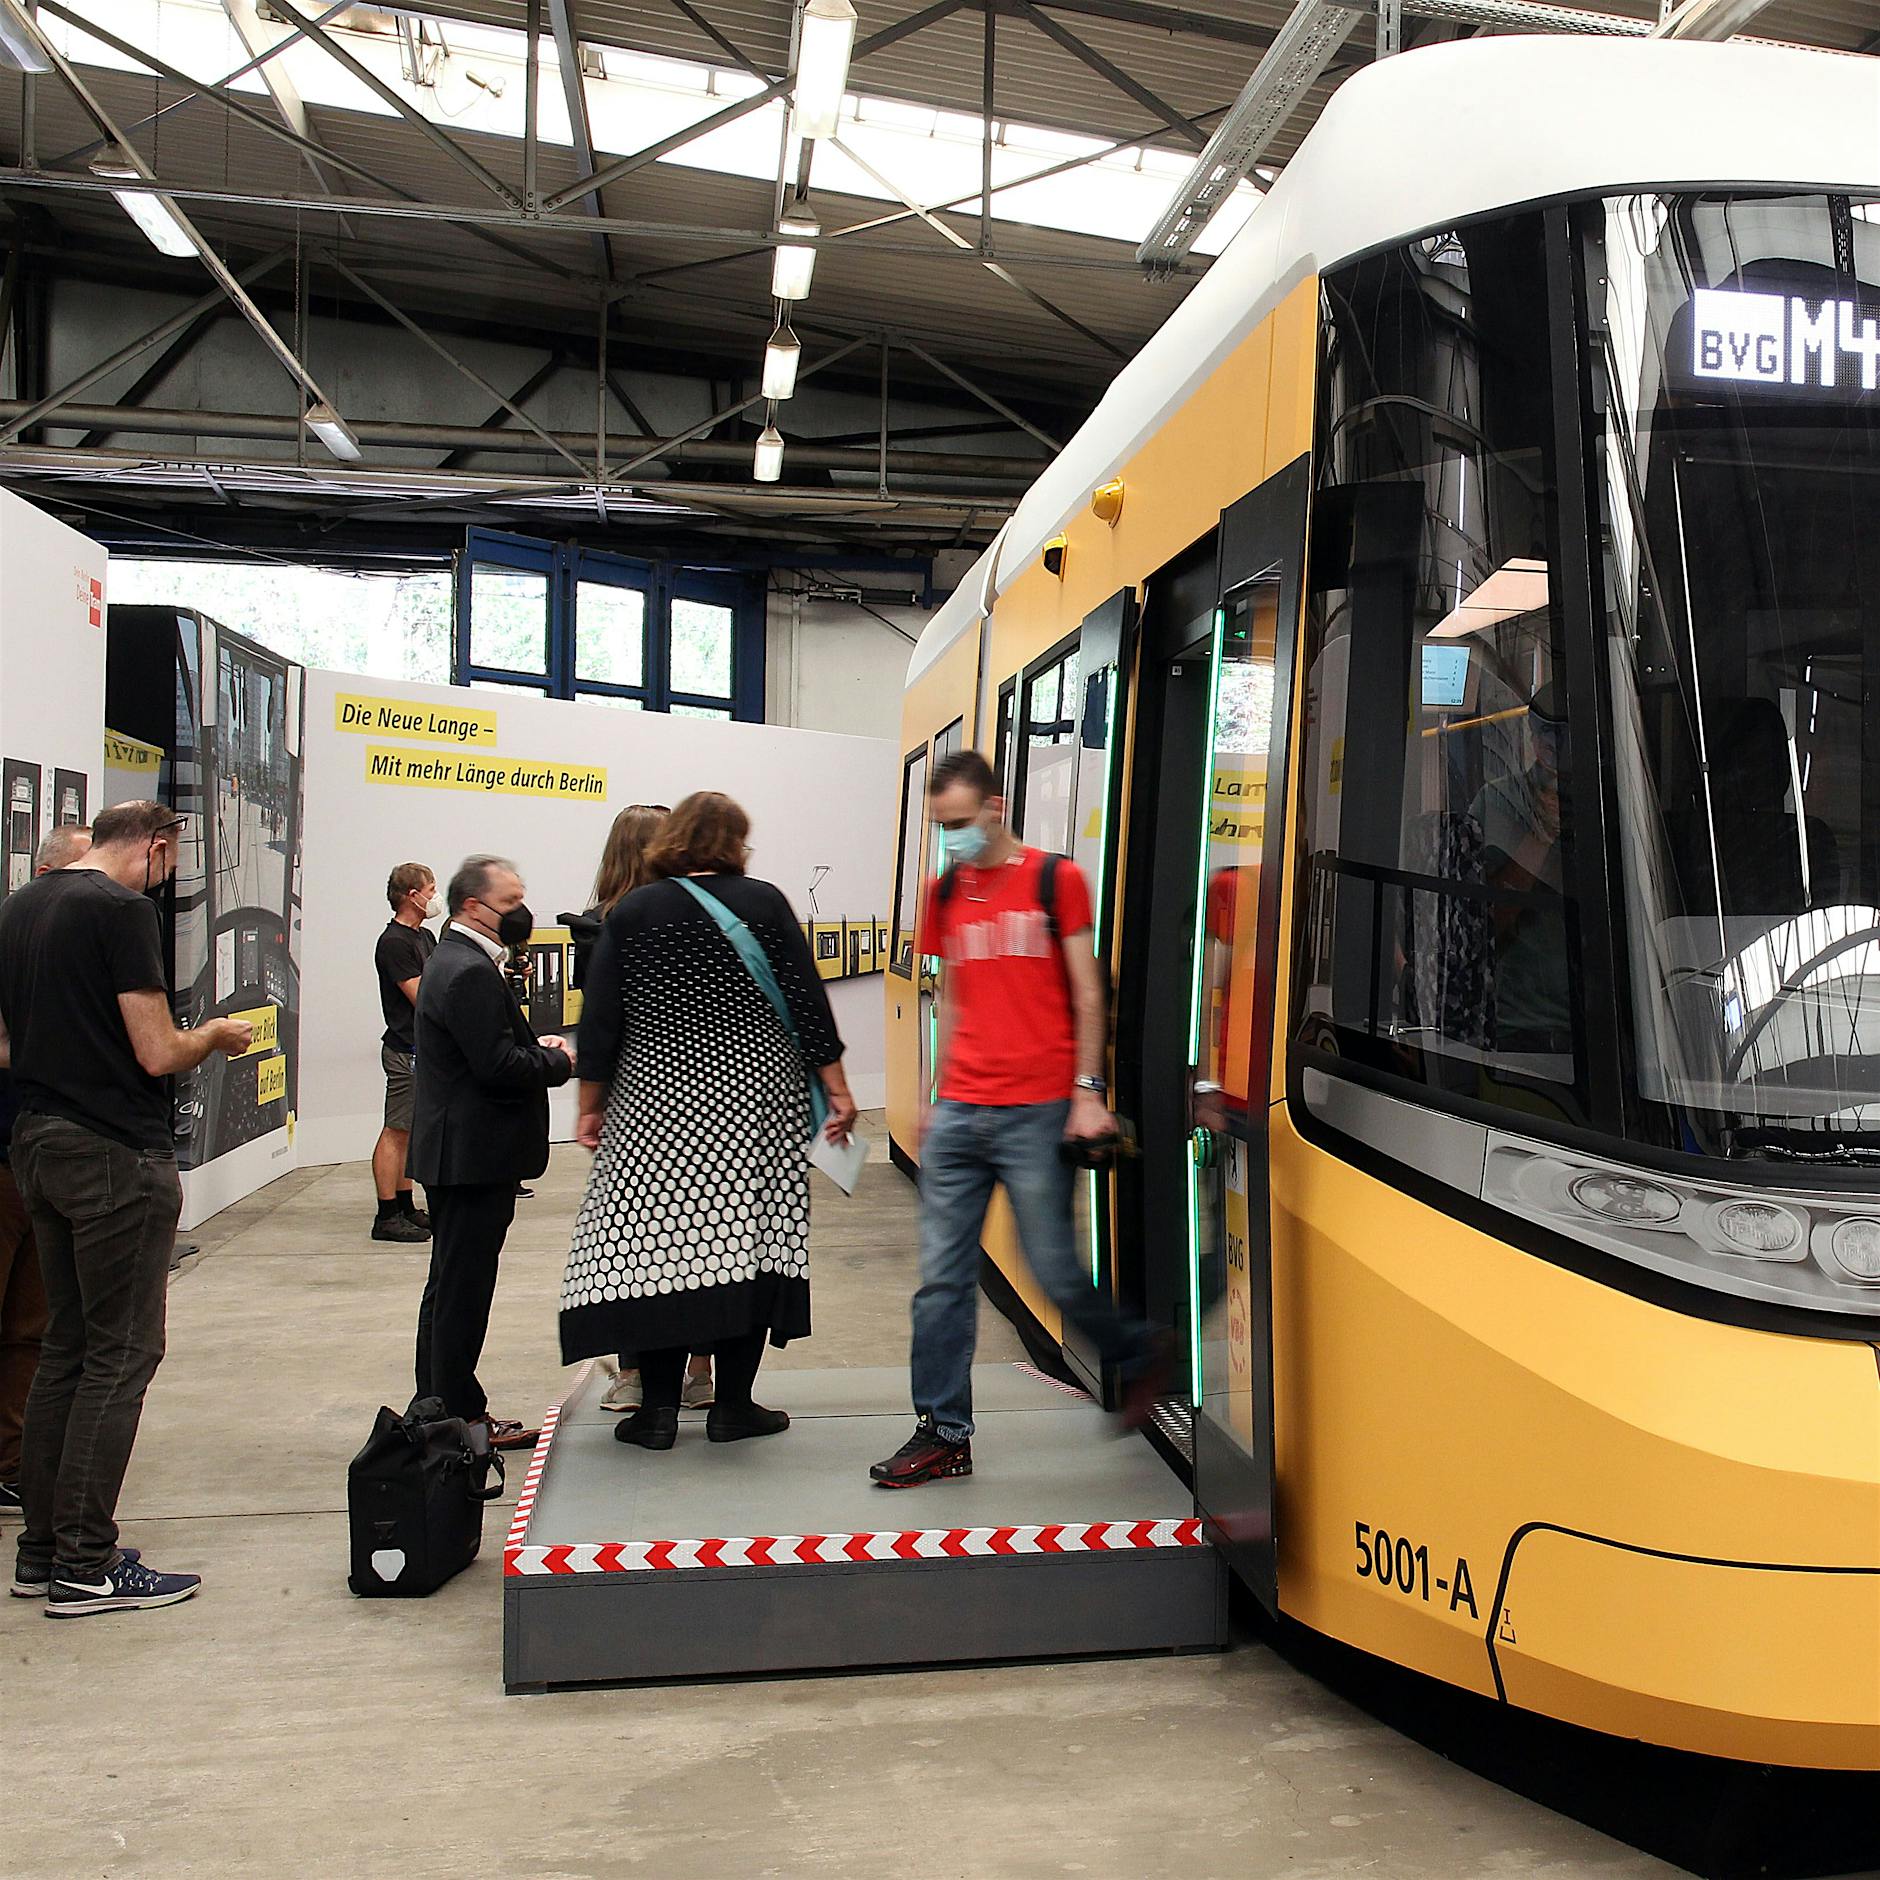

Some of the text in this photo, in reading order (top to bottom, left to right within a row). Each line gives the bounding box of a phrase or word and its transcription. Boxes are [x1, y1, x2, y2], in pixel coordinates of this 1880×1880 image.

[1700, 296, 1880, 390] BVG M4
[342, 703, 372, 726] Die
[377, 707, 423, 731] Neue
[428, 713, 479, 742] Lange
[371, 754, 603, 794] Mit mehr Länge durch Berlin
[269, 1065, 284, 1092] Berlin
[1228, 1231, 1244, 1272] BVG
[1355, 1520, 1479, 1620] 5001-A
